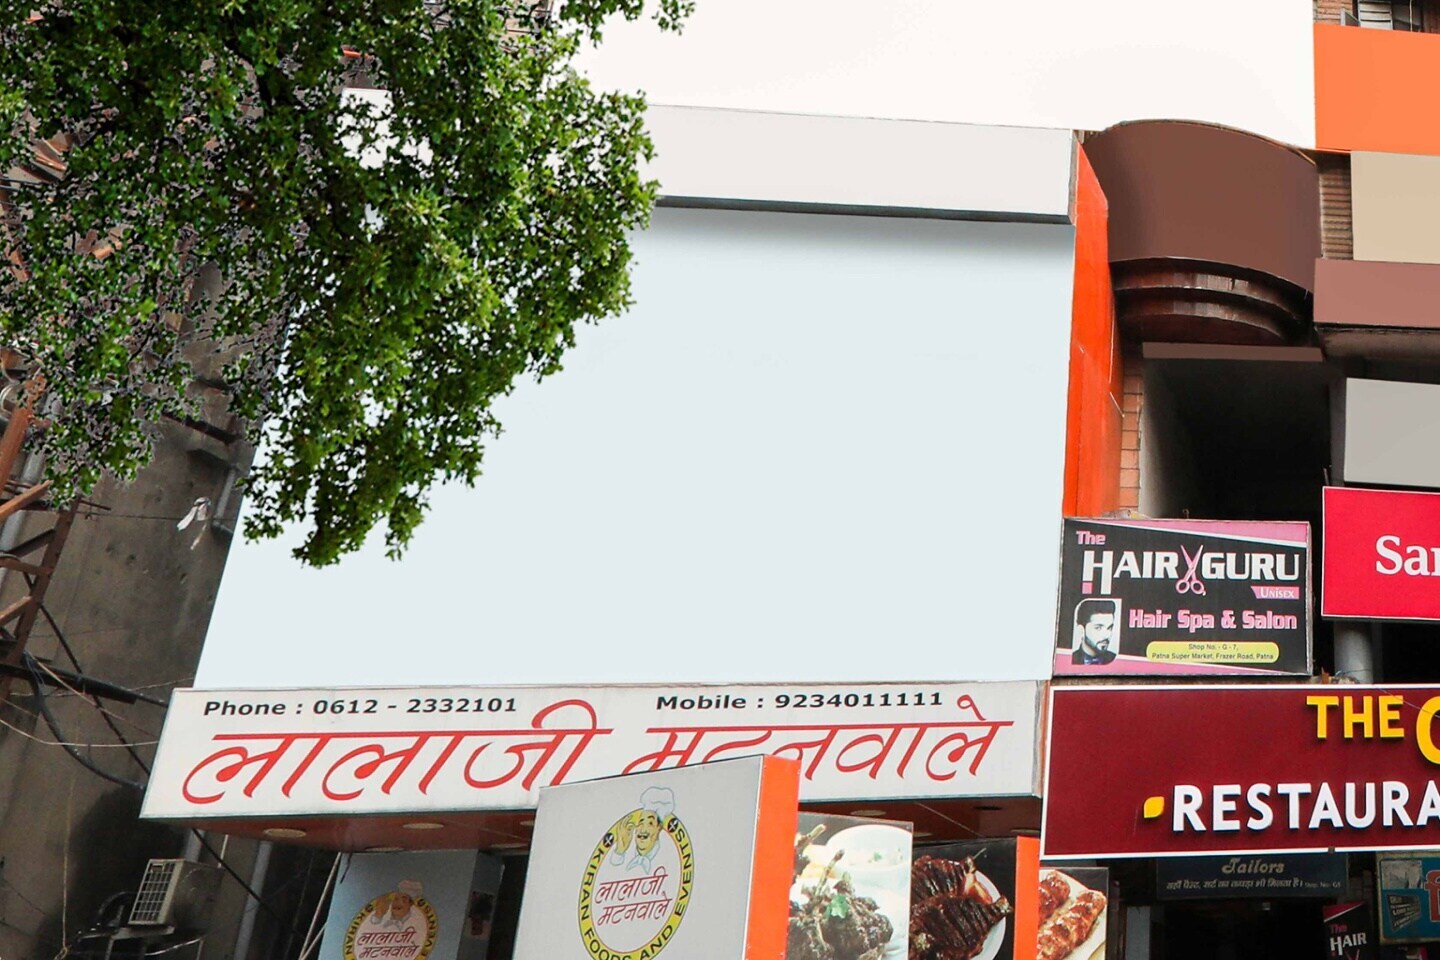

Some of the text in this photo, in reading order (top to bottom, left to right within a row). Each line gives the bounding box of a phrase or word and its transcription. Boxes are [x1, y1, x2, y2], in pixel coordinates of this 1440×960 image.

[1076, 530, 1106, 545] The
[1081, 550, 1300, 595] HAIR GURU
[1129, 609, 1298, 633] Hair Spa & Salon
[1171, 653, 1190, 661] Super
[1188, 643, 1204, 652] Shop
[203, 700, 286, 717] Phone
[312, 699, 379, 715] 0612
[406, 697, 518, 714] 2332101
[656, 694, 747, 711] Mobile
[773, 691, 944, 709] 9234011111
[1306, 695, 1405, 739] THE
[182, 699, 614, 805] लालाजी
[1221, 857, 1286, 875] Tailors
[580, 847, 606, 921] KIRAN
[639, 924, 674, 960] AND
[674, 827, 693, 917] EVENTS
[594, 865, 669, 905] लालाजी
[597, 890, 673, 926] मटनवाले
[1329, 932, 1367, 957] HAIR
